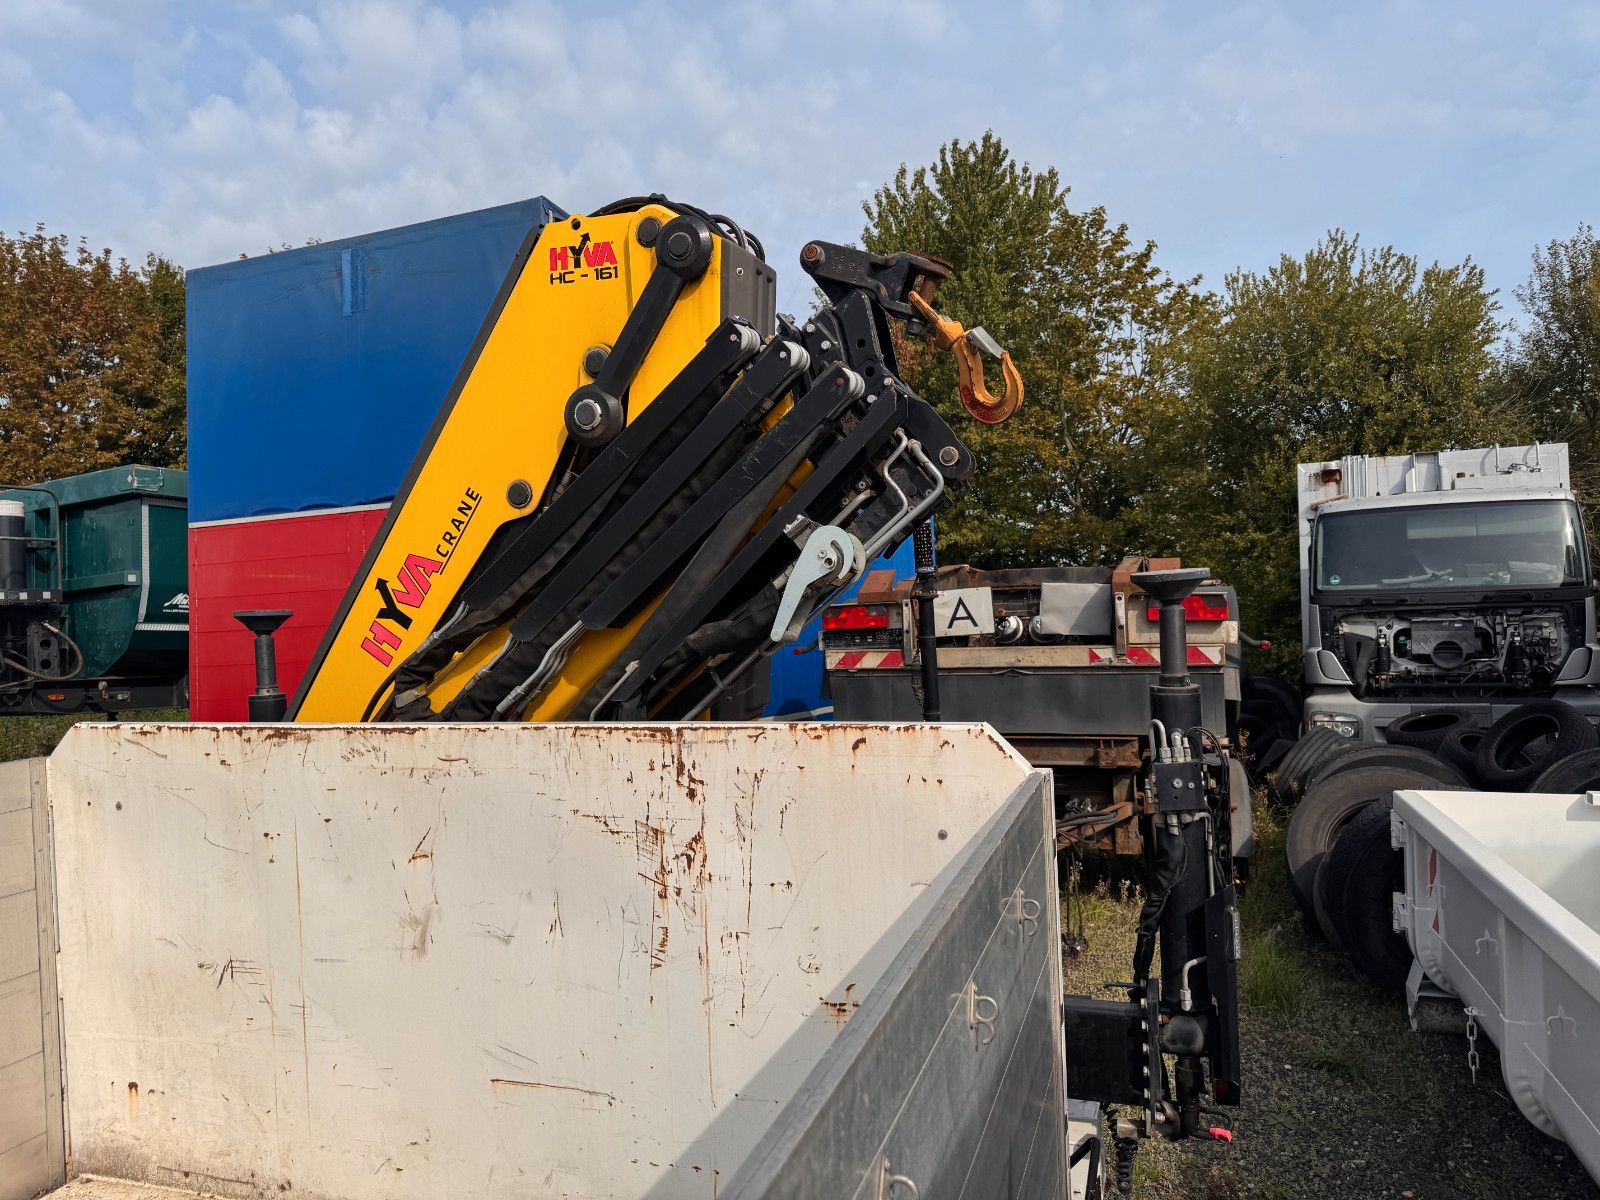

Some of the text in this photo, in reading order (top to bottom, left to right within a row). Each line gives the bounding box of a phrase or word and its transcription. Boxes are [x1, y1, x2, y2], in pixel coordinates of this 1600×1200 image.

[550, 233, 618, 271] HYVA
[550, 271, 575, 285] HC
[594, 266, 618, 280] 161
[361, 487, 480, 667] HYVA CRANE
[947, 596, 978, 629] A
